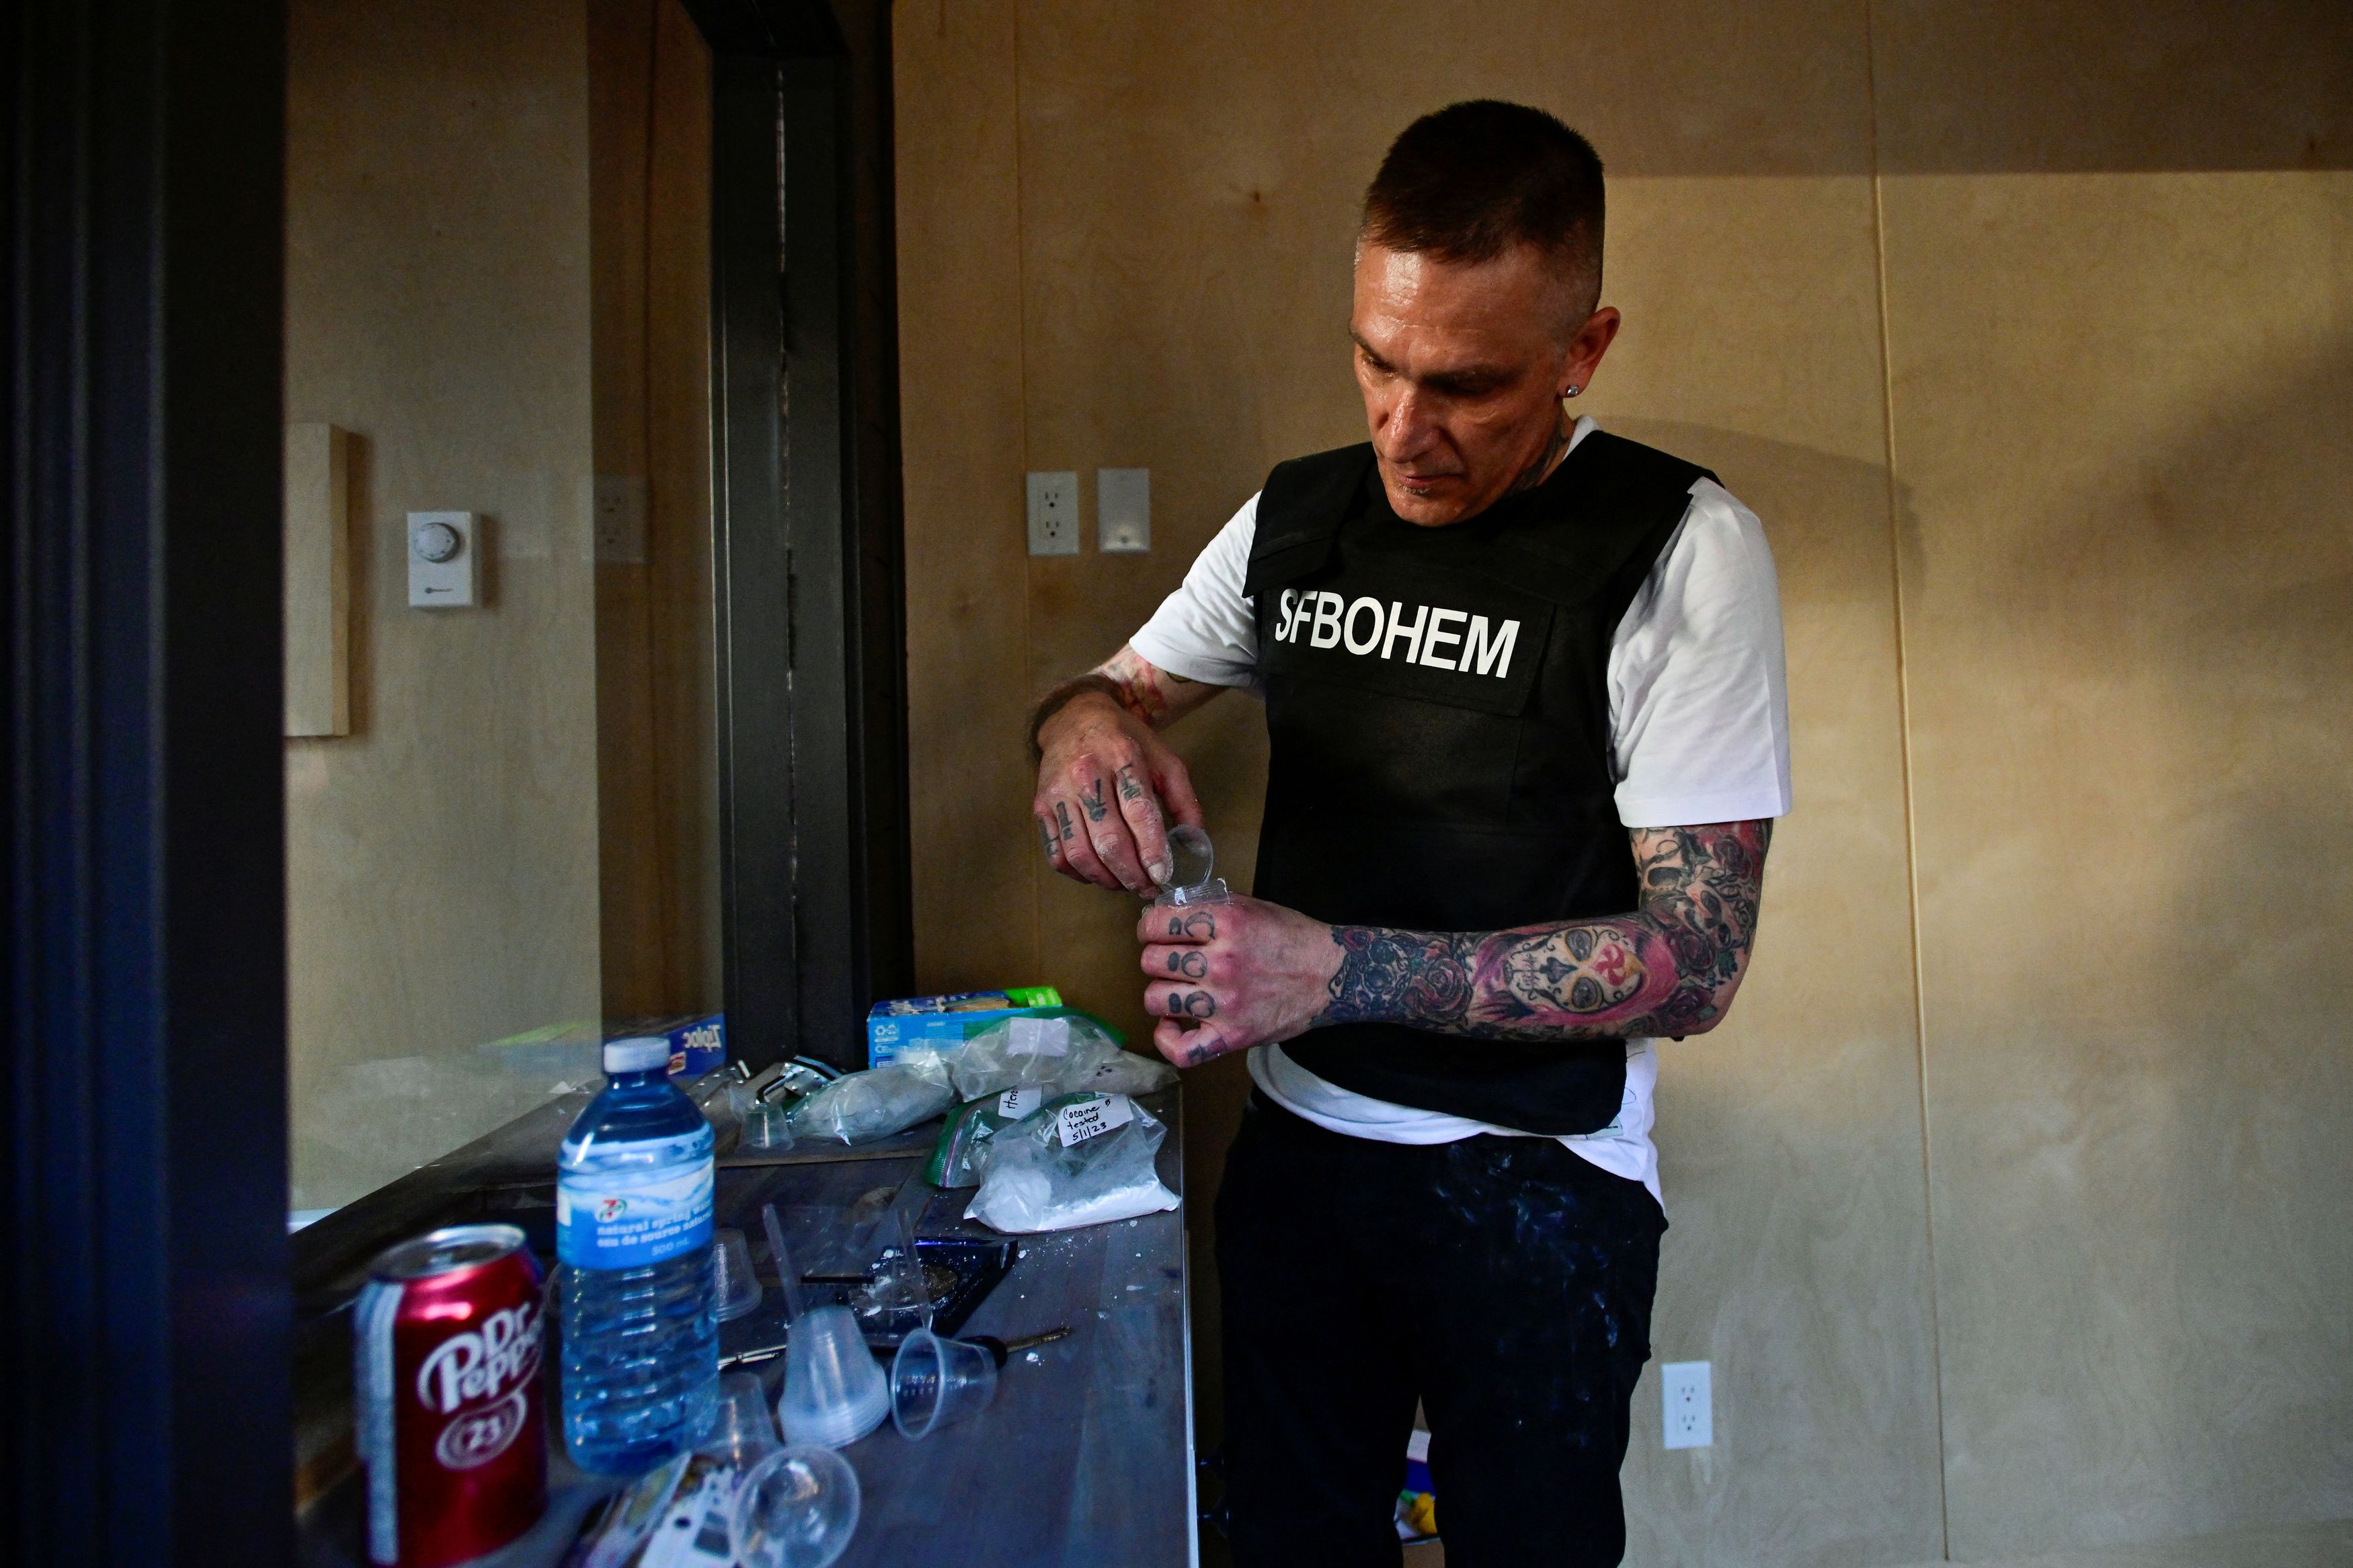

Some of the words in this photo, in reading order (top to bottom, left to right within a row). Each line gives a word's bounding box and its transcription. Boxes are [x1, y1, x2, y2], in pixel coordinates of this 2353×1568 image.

[1275, 588, 1521, 678] SFBOHEM
[1063, 1106, 1101, 1120] Cocaine
[1067, 1112, 1099, 1130] tested
[1072, 1122, 1107, 1141] 5/1/23
[482, 1301, 530, 1360] Dr
[467, 1415, 502, 1451] 23
